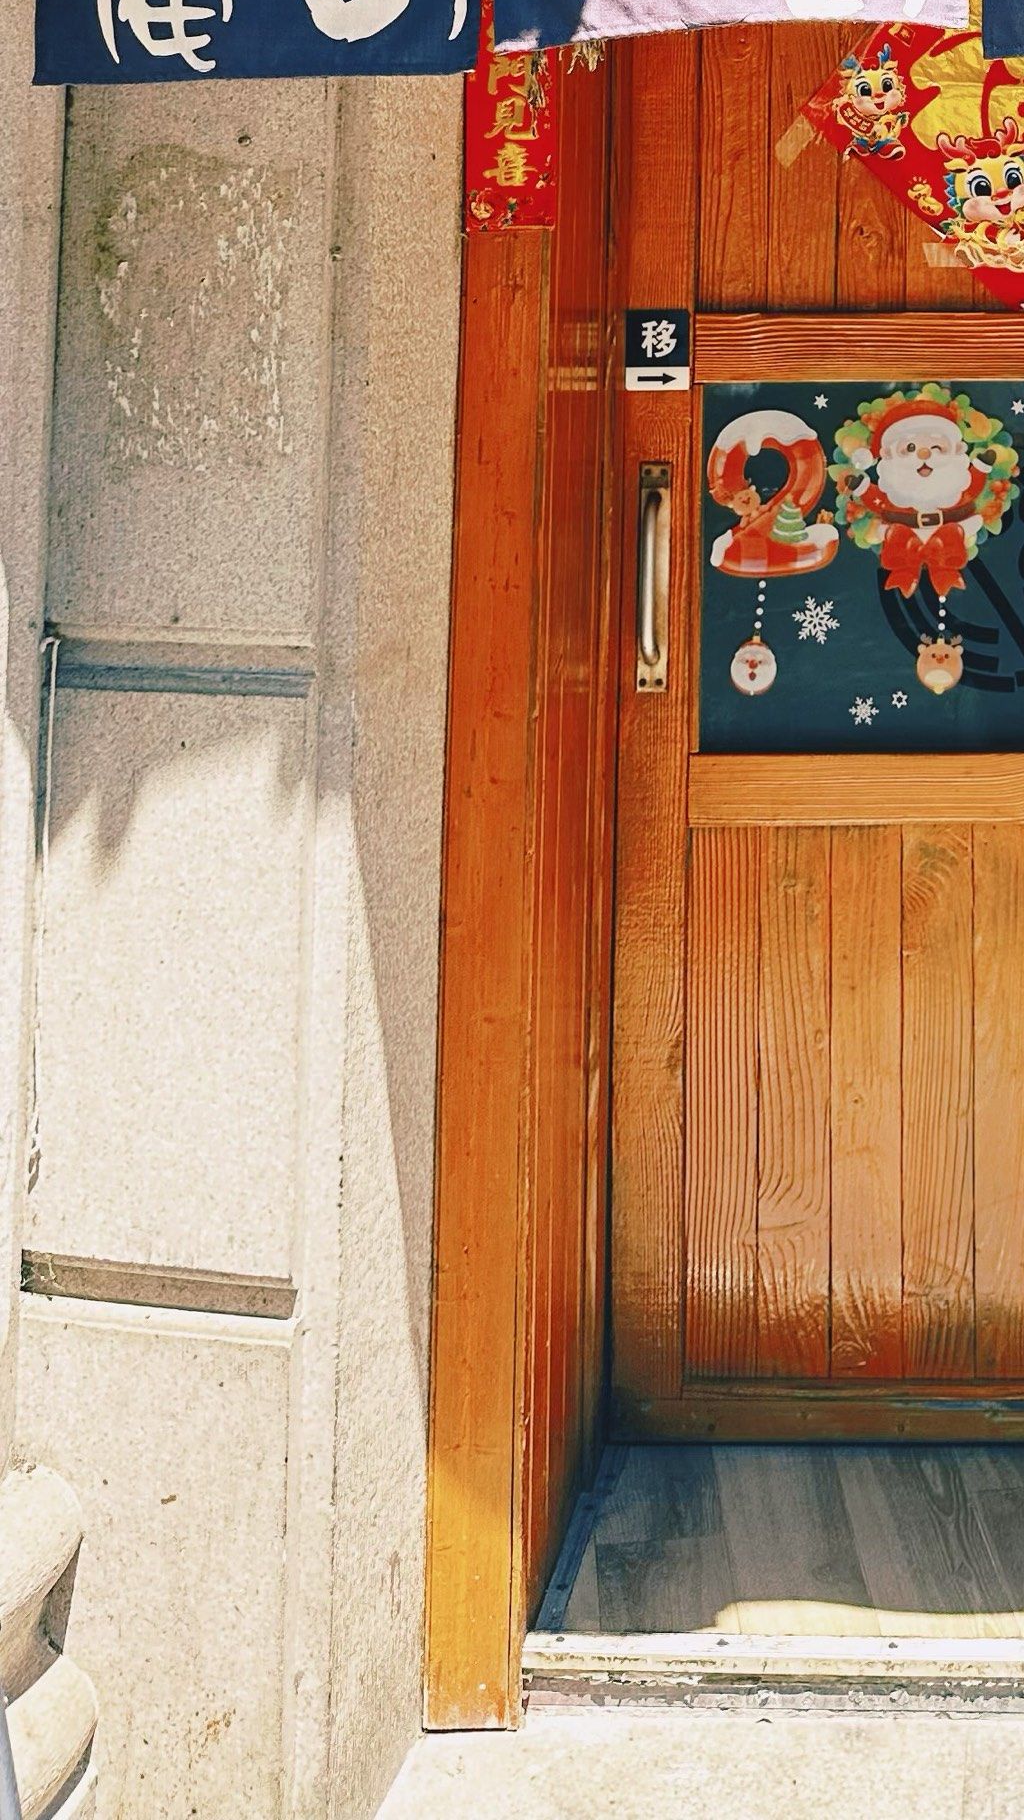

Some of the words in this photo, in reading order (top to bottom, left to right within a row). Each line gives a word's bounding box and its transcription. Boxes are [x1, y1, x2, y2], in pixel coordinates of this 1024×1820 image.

[482, 22, 539, 187] 門見喜
[640, 318, 677, 359] 移
